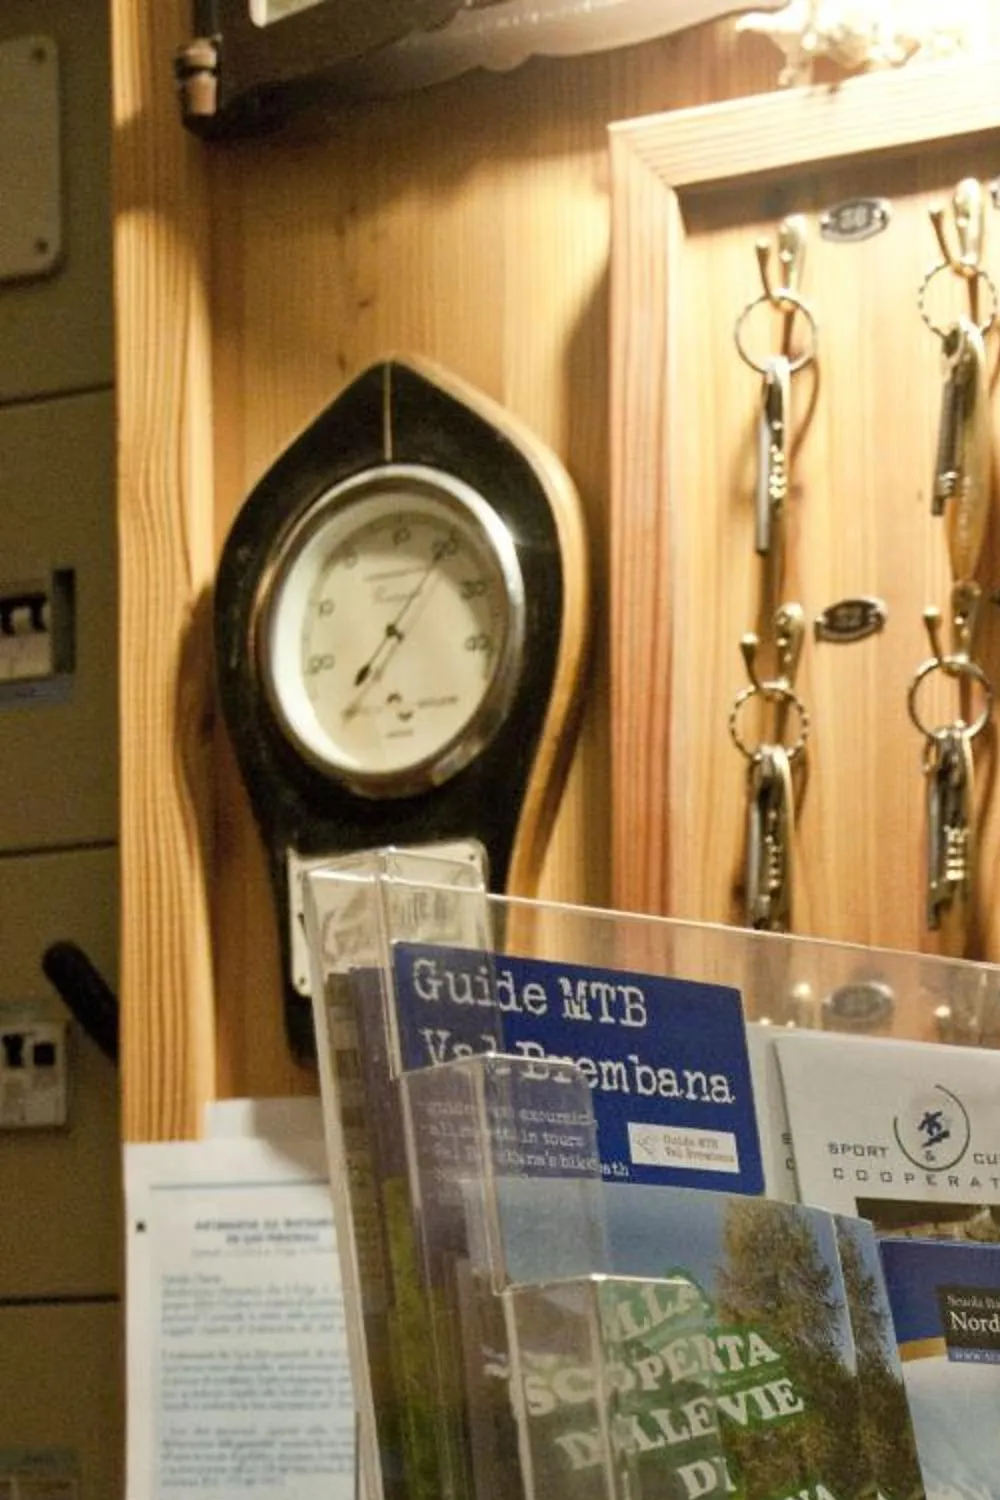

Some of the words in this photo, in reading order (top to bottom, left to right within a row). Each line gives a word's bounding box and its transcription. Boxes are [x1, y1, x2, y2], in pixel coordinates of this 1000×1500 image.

[412, 957, 548, 1017] Guide
[558, 975, 648, 1028] MTB
[516, 1040, 736, 1104] Brembana
[827, 1141, 890, 1159] SPORT
[713, 1378, 804, 1426] VIE
[676, 1455, 738, 1500] DI
